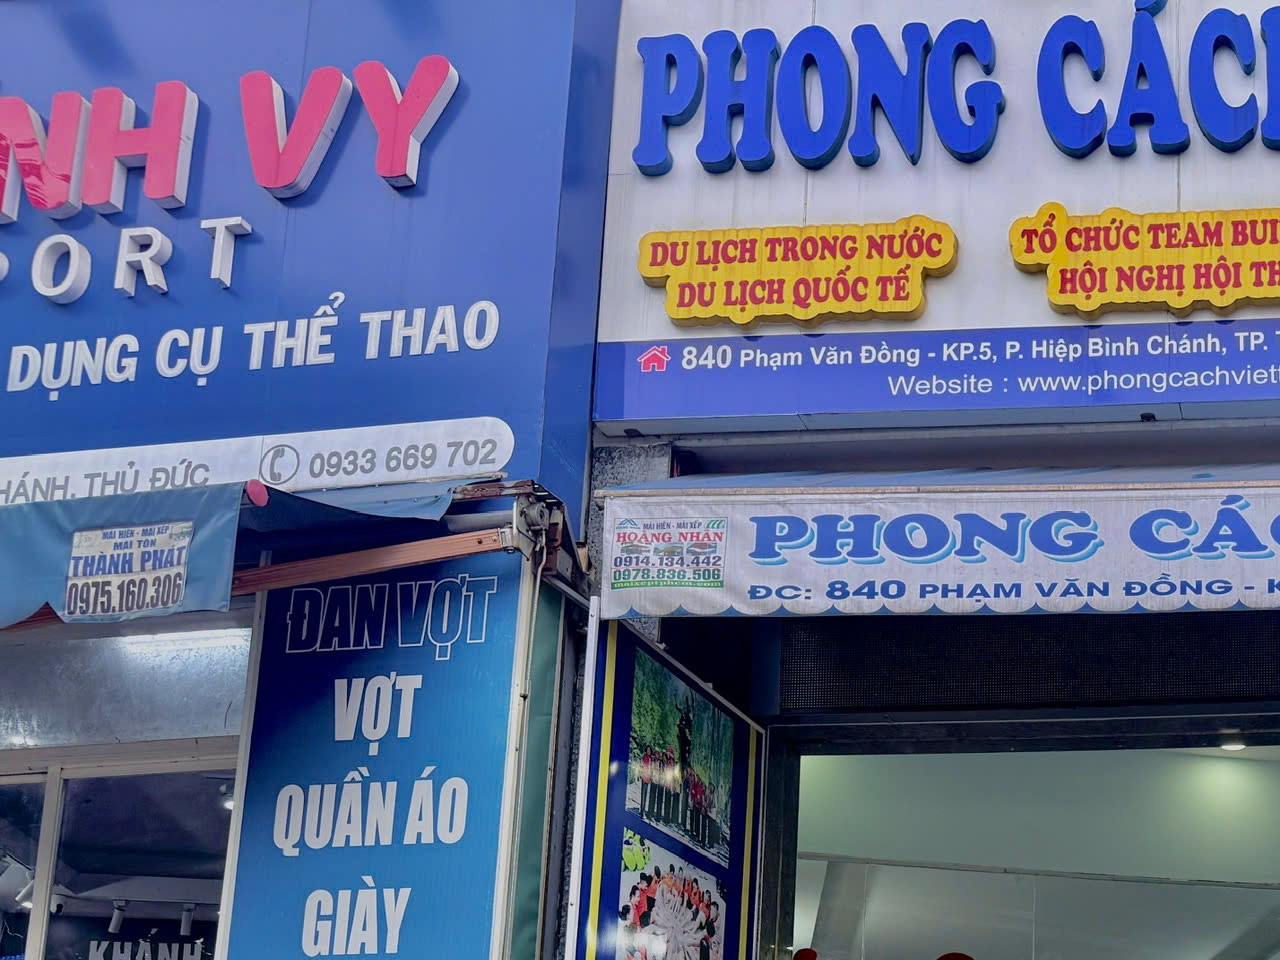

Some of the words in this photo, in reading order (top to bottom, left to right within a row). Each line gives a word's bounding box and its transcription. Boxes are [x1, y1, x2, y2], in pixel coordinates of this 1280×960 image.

[633, 18, 1004, 176] PHONG
[0, 81, 199, 224] NH
[240, 55, 460, 199] VY
[649, 241, 688, 266] DU
[696, 238, 757, 271] LỊCH
[766, 234, 858, 263] TRONG
[866, 226, 943, 260] NƯỚC
[1022, 213, 1057, 253] TỔ
[1065, 218, 1140, 252] CHỨC
[1147, 221, 1223, 249] TEAM
[0, 217, 252, 304] ORT
[1059, 260, 1107, 300] HỘI
[1116, 264, 1185, 296] NGHỊ
[1193, 255, 1242, 295] HỘI
[676, 281, 716, 308] DU
[724, 278, 785, 312] LỊCH
[792, 265, 868, 309] QUỐC
[875, 264, 911, 302] TẾ
[7, 334, 140, 402] DỤNG
[155, 325, 224, 387] CỤ
[242, 291, 346, 370] THỂ
[359, 300, 500, 360] THAO
[681, 345, 733, 371] 840
[739, 349, 802, 371] Phạm
[809, 346, 852, 365] Văn
[859, 341, 920, 367] Đồng
[942, 341, 998, 364] KP.5,
[1005, 342, 1025, 360] P.
[1031, 338, 1083, 363] Hiệp
[1088, 337, 1139, 359] Bình
[1146, 333, 1227, 357] Chánh,
[1234, 331, 1269, 352] TP.
[888, 374, 993, 396] Website
[84, 461, 140, 494] THỦ
[149, 459, 210, 491] ĐỨC
[308, 447, 377, 479] 0933
[385, 444, 438, 473] 669
[445, 438, 498, 467] 702
[72, 551, 134, 577] THÀNH
[140, 545, 186, 572] PHÁT
[614, 555, 722, 568] 0914.134.442
[749, 510, 1105, 566] PHONG
[67, 572, 183, 615] 0975.160.306
[747, 584, 812, 600] ĐC:
[825, 580, 906, 600] 840
[919, 583, 1022, 602] PHẠM
[1034, 578, 1110, 598] VĂN
[1122, 573, 1233, 597] ĐỒNG
[286, 588, 389, 653] ĐAN
[397, 574, 498, 660] VỢT
[334, 672, 422, 756] VỢT
[273, 766, 396, 856] QUẦN
[404, 765, 470, 844] ÁO
[302, 876, 411, 957] GIÀY
